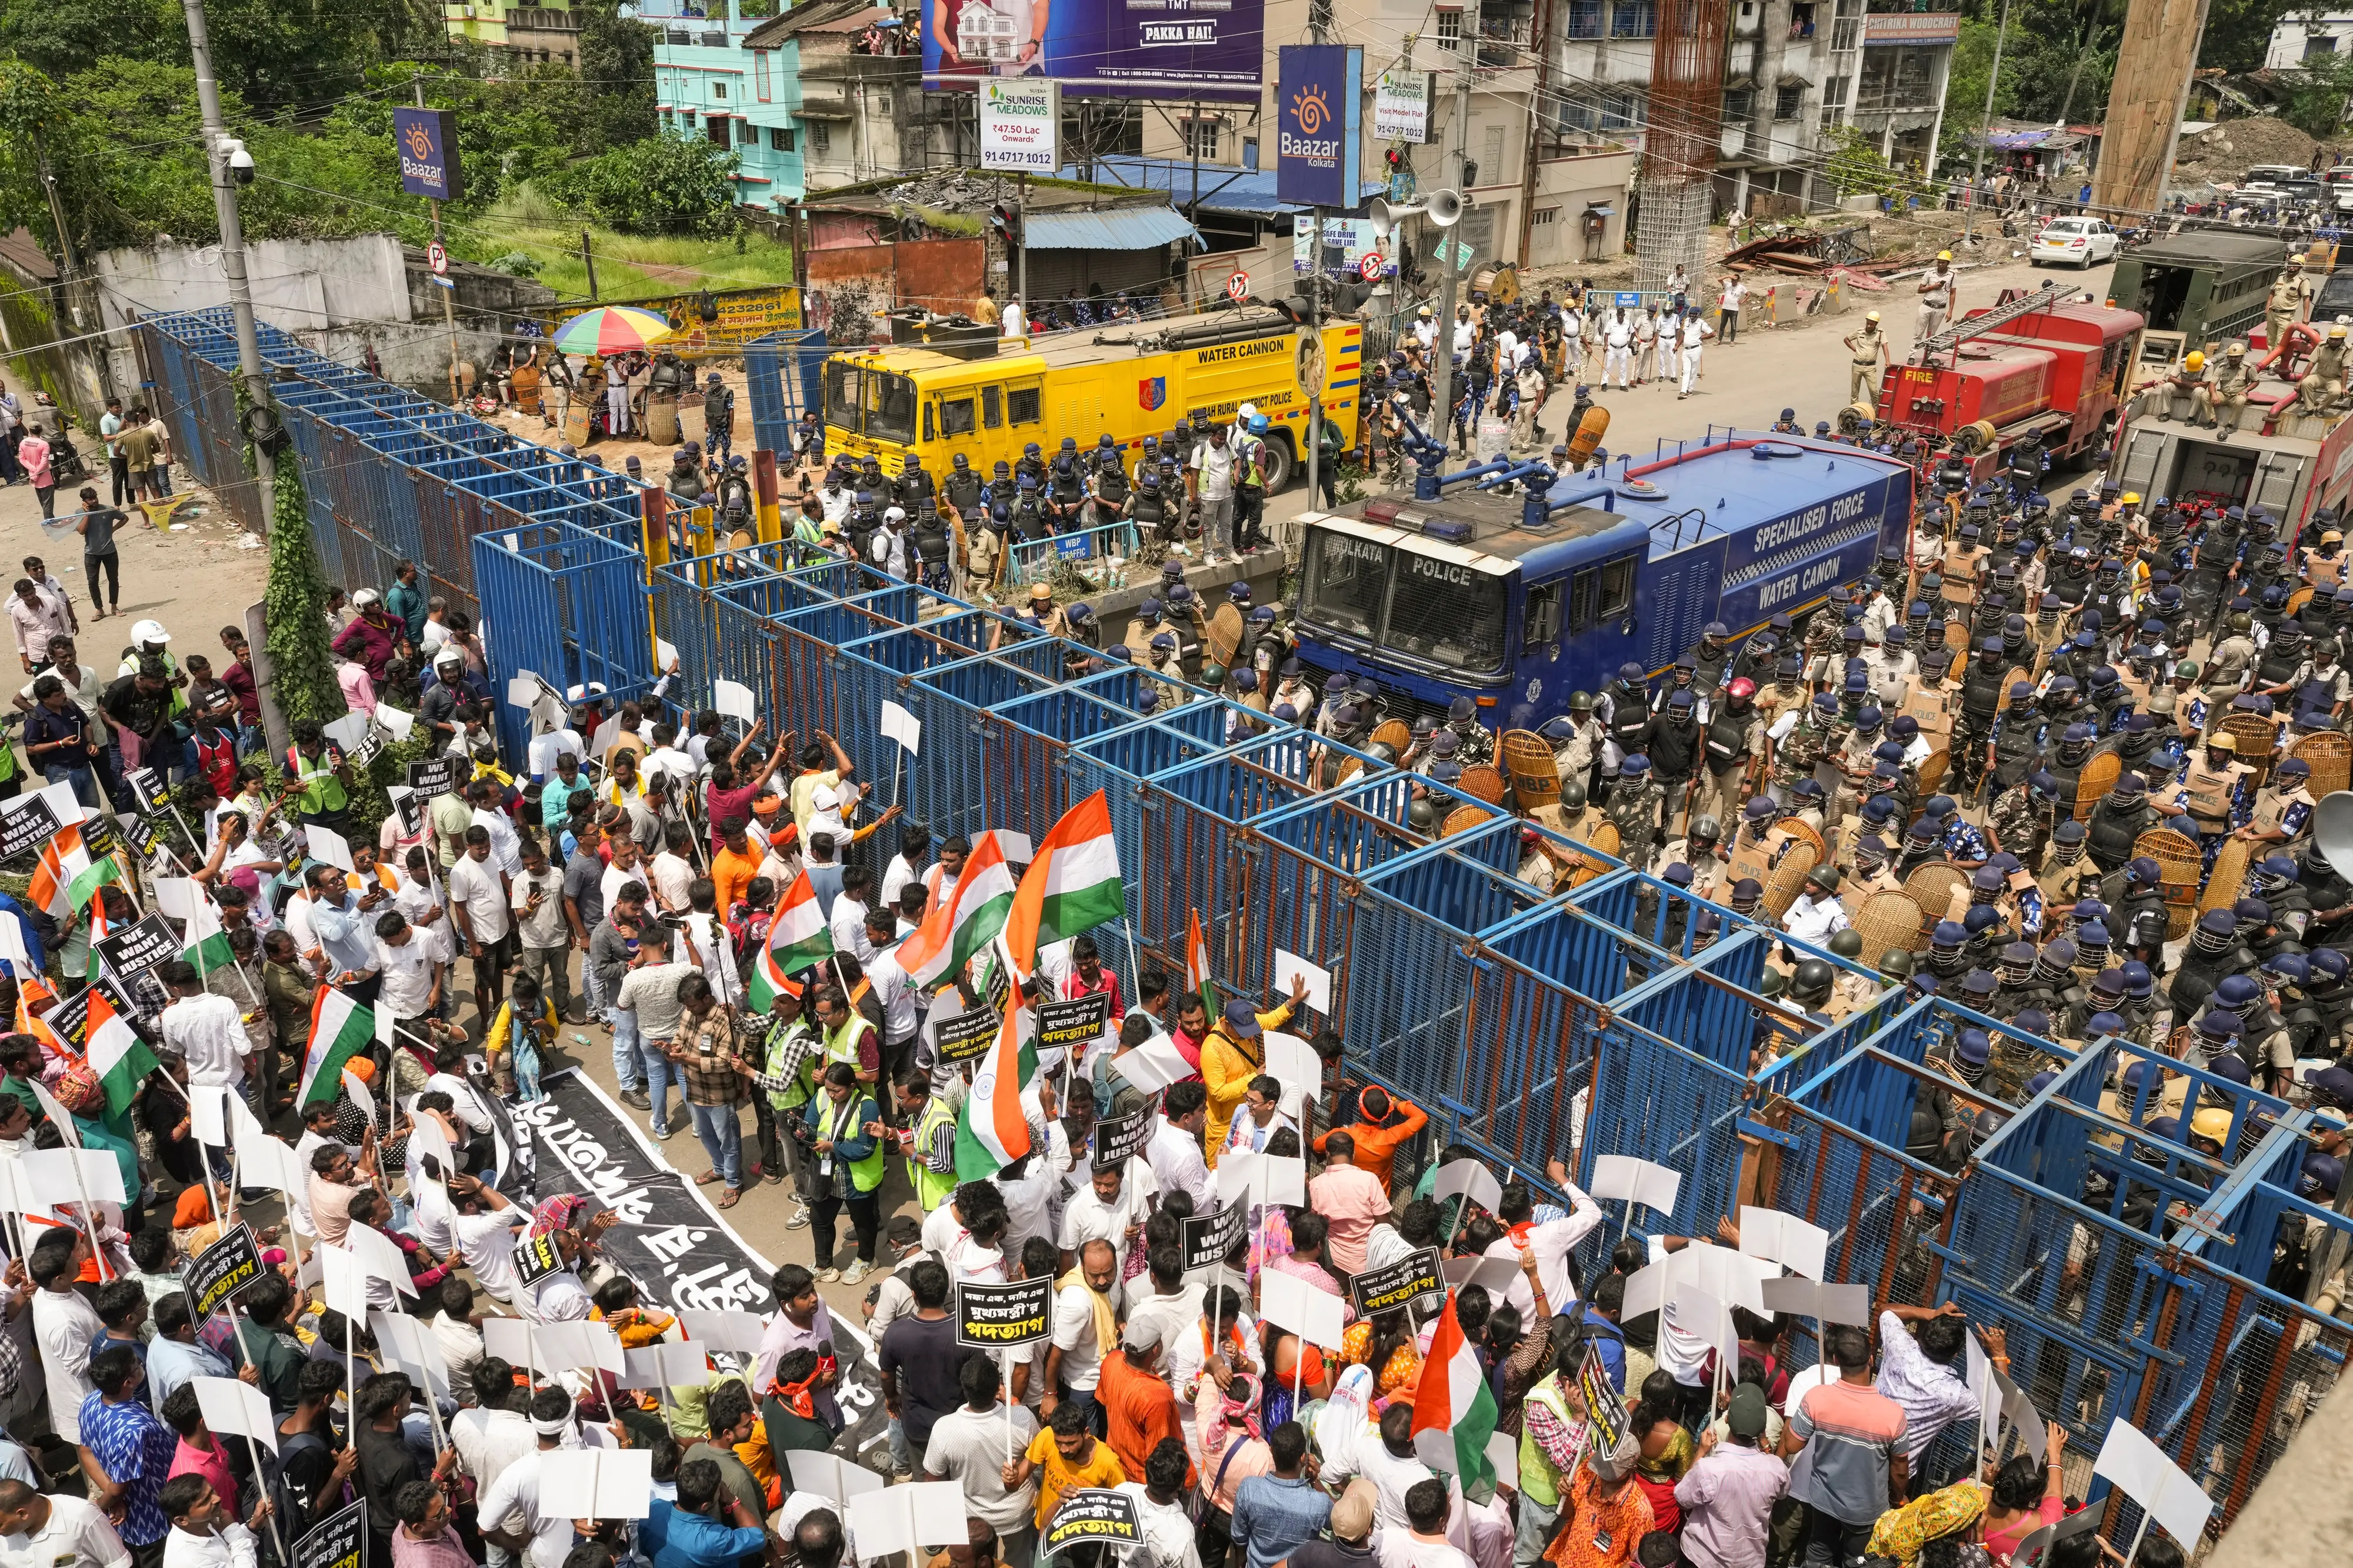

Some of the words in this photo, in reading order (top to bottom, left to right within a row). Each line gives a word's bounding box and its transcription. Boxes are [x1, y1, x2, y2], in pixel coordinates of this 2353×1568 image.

[1168, 0, 1188, 9] TMT
[1869, 17, 1907, 29] CHITRIKA
[1909, 16, 1958, 29] WOODCRAFT
[1146, 27, 1184, 40] PAKKA
[1187, 26, 1212, 39] HAI!
[1388, 89, 1422, 99] MEADOWS
[1394, 82, 1422, 91] SUNRISE
[996, 105, 1047, 115] MEADOWS
[1006, 95, 1046, 105] SUNRISE
[993, 125, 1022, 134] ₹47.50
[1025, 126, 1039, 134] Lac
[1377, 125, 1385, 133] 91
[1405, 128, 1422, 137] 1012
[1281, 132, 1339, 156] Baazar
[402, 156, 441, 179] Baazar
[985, 151, 997, 161] 91
[999, 152, 1024, 162] 4717
[1026, 154, 1051, 164] 1012
[1308, 157, 1335, 168] Kolkata
[423, 178, 441, 188] Kolkata
[1198, 346, 1237, 363] WATER
[1238, 339, 1284, 358] CANNON
[112, 358, 122, 381] TMC
[1905, 371, 1934, 383] FIRE
[2001, 379, 2012, 391] WEST
[2012, 374, 2027, 388] BENGAL
[2027, 371, 2037, 382] FIRE
[1218, 401, 1239, 416] RURAL
[1270, 391, 1292, 406] POLICE
[1997, 389, 2020, 405] EMERGENCY
[2020, 382, 2040, 397] SERVICES
[847, 434, 860, 444] WATER
[860, 438, 879, 449] CANNON
[1754, 505, 1827, 552] SPECIALISED
[1830, 491, 1866, 524] FORCE
[1065, 537, 1081, 549] WBP
[1412, 555, 1472, 586] POLICE
[1949, 566, 1968, 577] POLICE
[1759, 573, 1798, 610] WATER
[1802, 556, 1841, 591] CANON
[1914, 709, 1937, 721] POLICE
[428, 762, 445, 773] WE
[419, 771, 449, 785] WANT
[1517, 775, 1551, 792] WBP
[414, 781, 452, 796] JUSTICE
[2191, 791, 2219, 806] POLICE
[5, 808, 30, 826] WE
[1, 813, 45, 842] WANT
[4, 820, 56, 855] JUSTICE
[1737, 861, 1762, 879] POLICE
[119, 926, 146, 946] WE
[116, 932, 161, 961] WANT
[119, 939, 175, 976] JUSTICE
[1060, 1007, 1075, 1016] এক,
[1075, 1003, 1090, 1013] দাবি
[1090, 1001, 1102, 1010] এক
[1041, 1022, 1101, 1043] পদত্যাগ
[951, 1046, 978, 1058] পদত্যাগ
[1110, 1117, 1151, 1147] WANT
[1122, 1112, 1144, 1132] WE
[1102, 1127, 1154, 1162] JUSTICE
[1213, 1206, 1235, 1230] WE
[1200, 1213, 1241, 1248] WANT
[1191, 1222, 1244, 1265] JUSTICE
[189, 1272, 200, 1287] দফা
[212, 1246, 230, 1261] দাবি
[231, 1235, 245, 1249] এক
[1359, 1277, 1377, 1286] দফা
[1378, 1271, 1396, 1283] এক,
[1396, 1261, 1414, 1275] দাবি
[1414, 1256, 1431, 1266] এক
[198, 1259, 254, 1315] পদত্যাগ
[964, 1292, 985, 1301] দফা
[986, 1291, 1006, 1303] এক,
[1008, 1289, 1028, 1301] দাবি
[1029, 1287, 1045, 1297] এক
[1365, 1276, 1435, 1308] পদত্যাগ
[965, 1315, 1045, 1340] পদত্যাগ
[1584, 1372, 1617, 1446] পদত্যাগ
[1048, 1469, 1064, 1486] WEAR
[1086, 1494, 1108, 1504] দাবি
[1109, 1496, 1126, 1506] এক
[299, 1549, 312, 1563] দফা
[312, 1539, 326, 1552] এক,
[327, 1524, 343, 1541] দাবি
[344, 1516, 359, 1530] এক
[1049, 1519, 1133, 1543] পদত্যাগ
